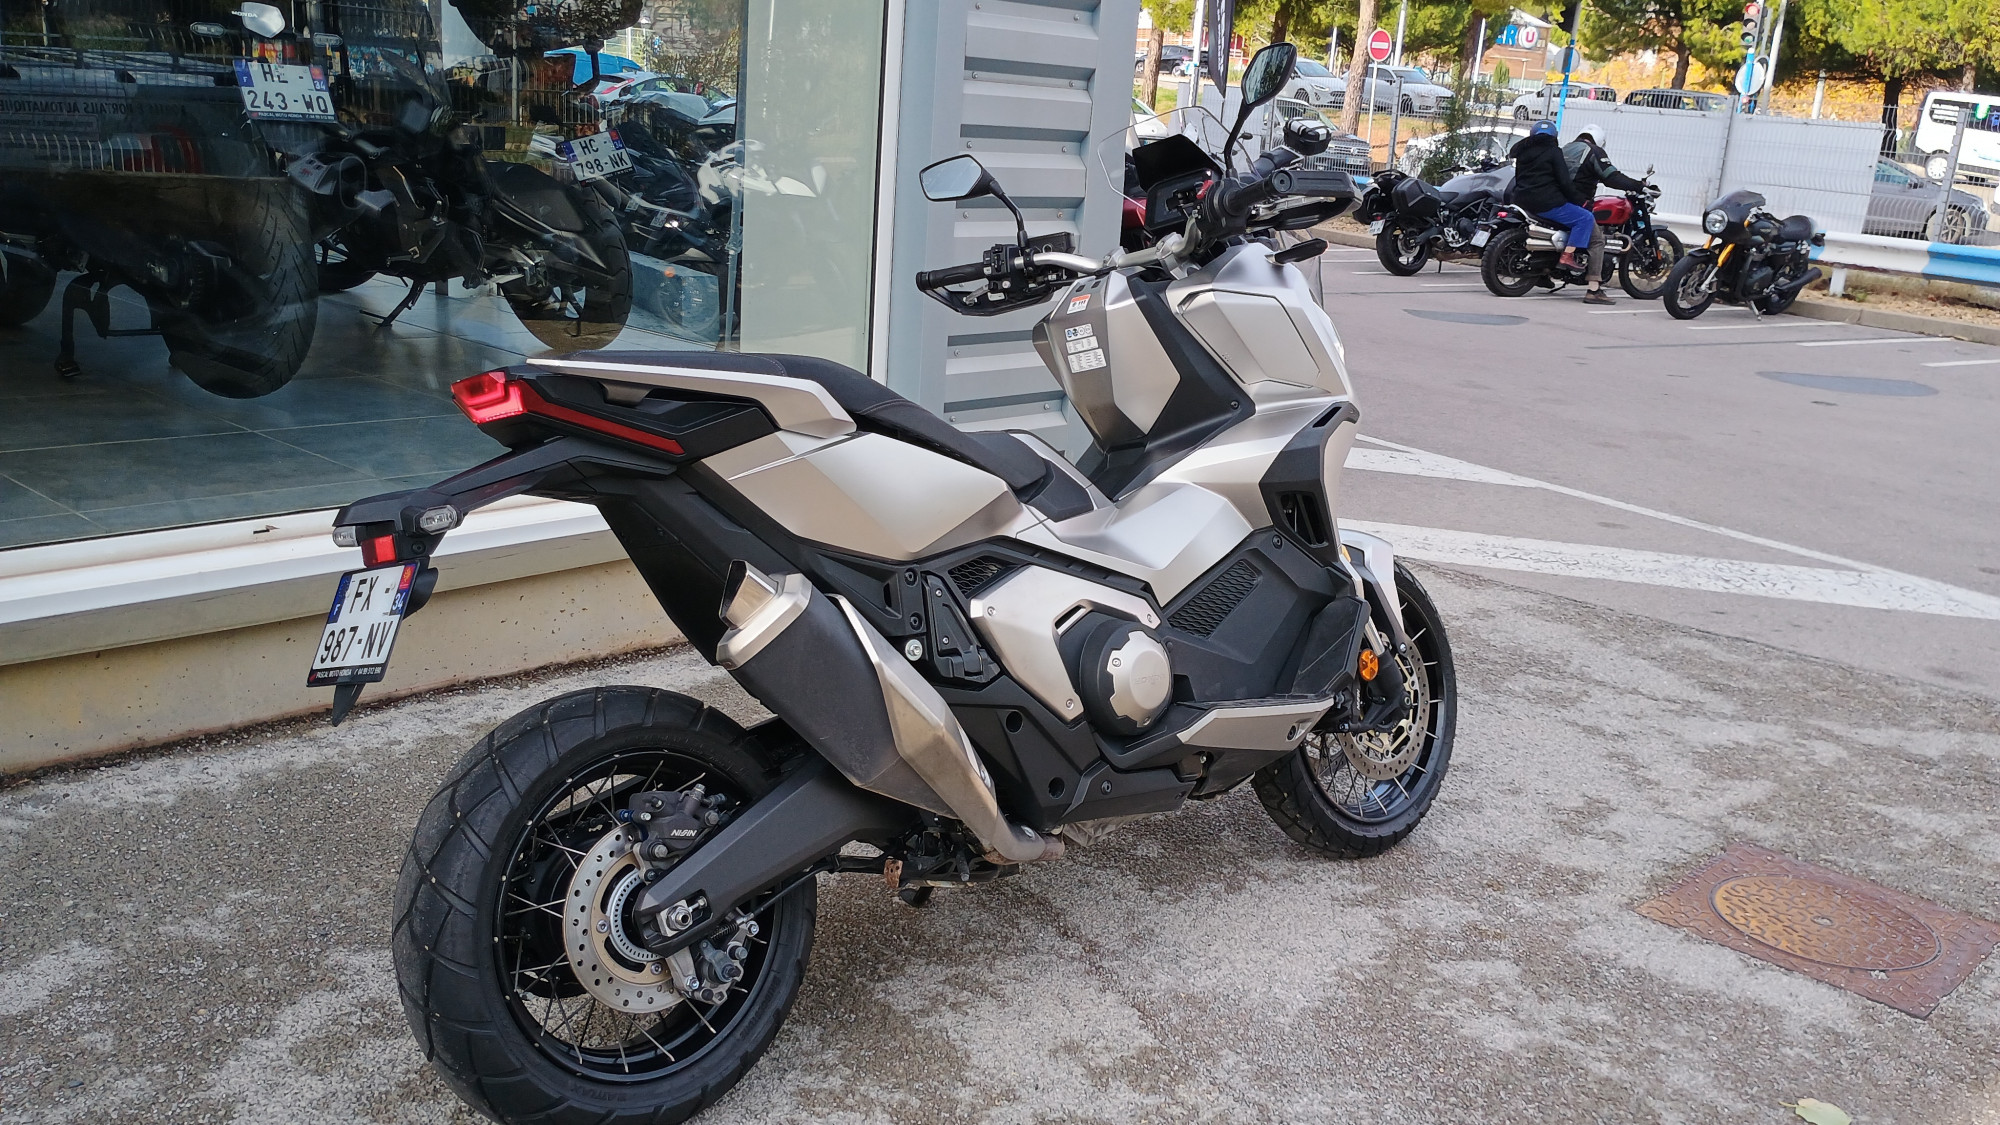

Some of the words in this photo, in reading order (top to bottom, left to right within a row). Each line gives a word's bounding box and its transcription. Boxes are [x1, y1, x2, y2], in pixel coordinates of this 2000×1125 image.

[579, 138, 599, 155] HC
[576, 152, 629, 177] 798-NK
[349, 576, 379, 614] FX
[392, 592, 406, 611] 34
[333, 604, 341, 616] F
[320, 620, 394, 664] 987-NV
